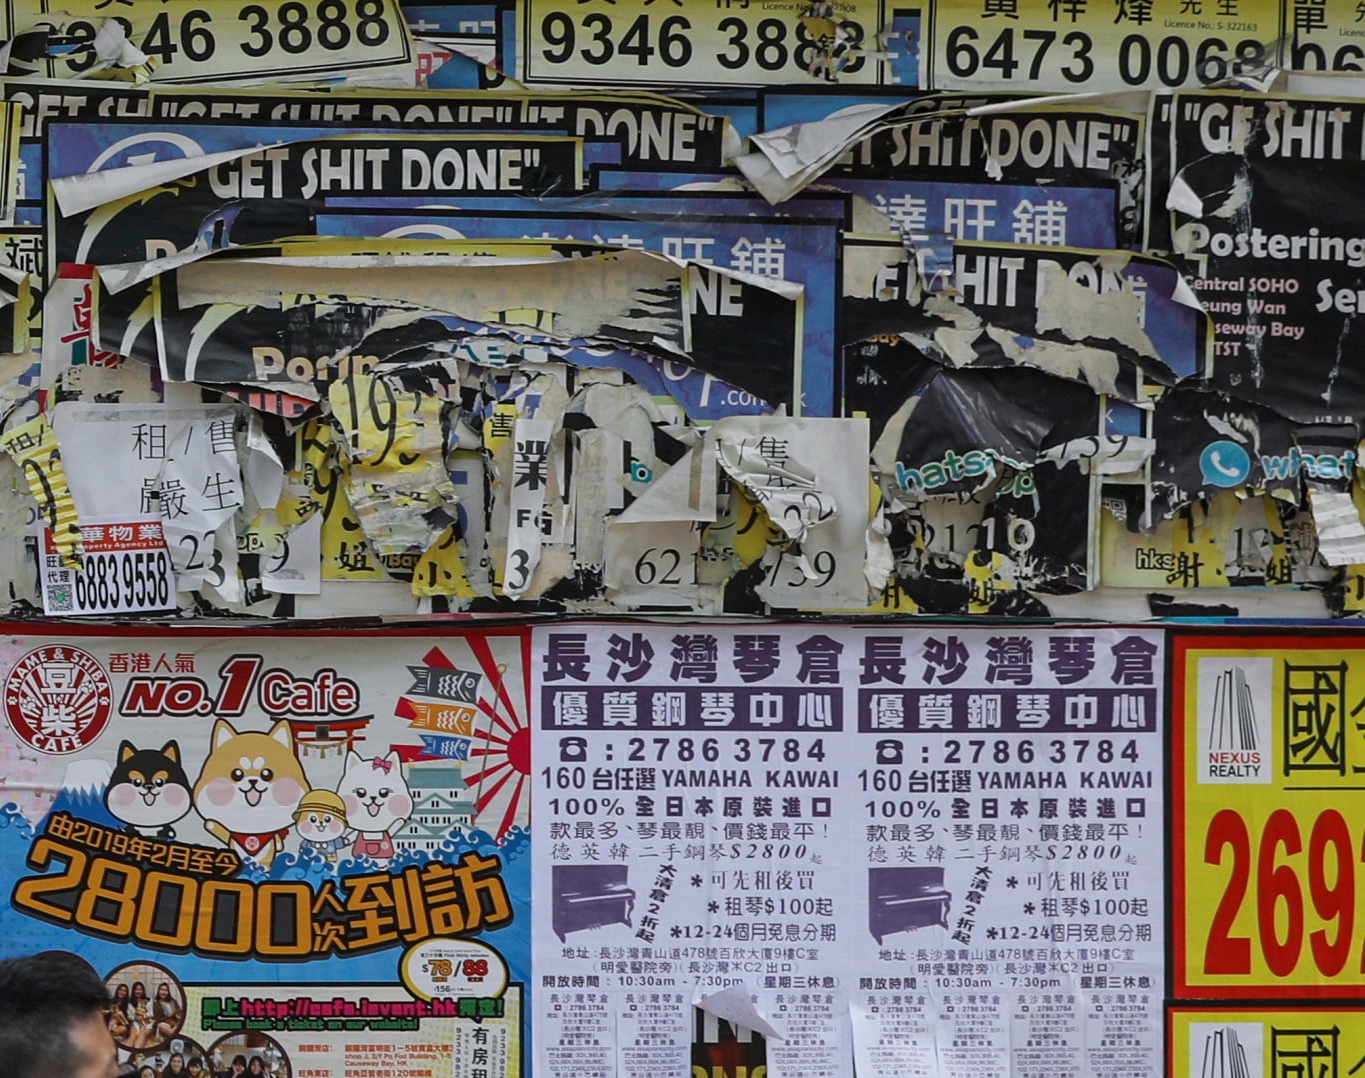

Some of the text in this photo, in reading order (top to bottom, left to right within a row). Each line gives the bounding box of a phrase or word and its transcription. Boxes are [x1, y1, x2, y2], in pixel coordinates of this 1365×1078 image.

[239, 6, 390, 69] 3888
[541, 15, 692, 66] 9346
[946, 27, 1094, 83] 6473
[991, 117, 1129, 170] DONE"
[208, 147, 539, 198] GET SHIT DONE"
[1188, 223, 1365, 267] Postering
[1248, 278, 1299, 293] SOHO
[1247, 299, 1286, 315] Wan
[1271, 322, 1304, 340] Bay
[1215, 342, 1241, 356] TST
[132, 420, 235, 460] 租/售
[114, 540, 147, 549] Agency
[76, 552, 168, 609] 6883 9558
[110, 653, 195, 673] 香港人氣
[542, 634, 844, 685] 長沙灣琴倉
[260, 669, 359, 713] Cafe
[552, 691, 834, 728] 優質鋼琴中心
[628, 738, 826, 763] 2786 3784
[1209, 752, 1261, 764] NEXUS
[542, 767, 839, 791] 160 台任選 YAMAHA KAWAI
[1209, 764, 1261, 777] REALTY
[549, 797, 832, 818] 100% 全日本原裝進口
[50, 816, 238, 876] 由2019年2月至今
[617, 976, 676, 989] 10:30am
